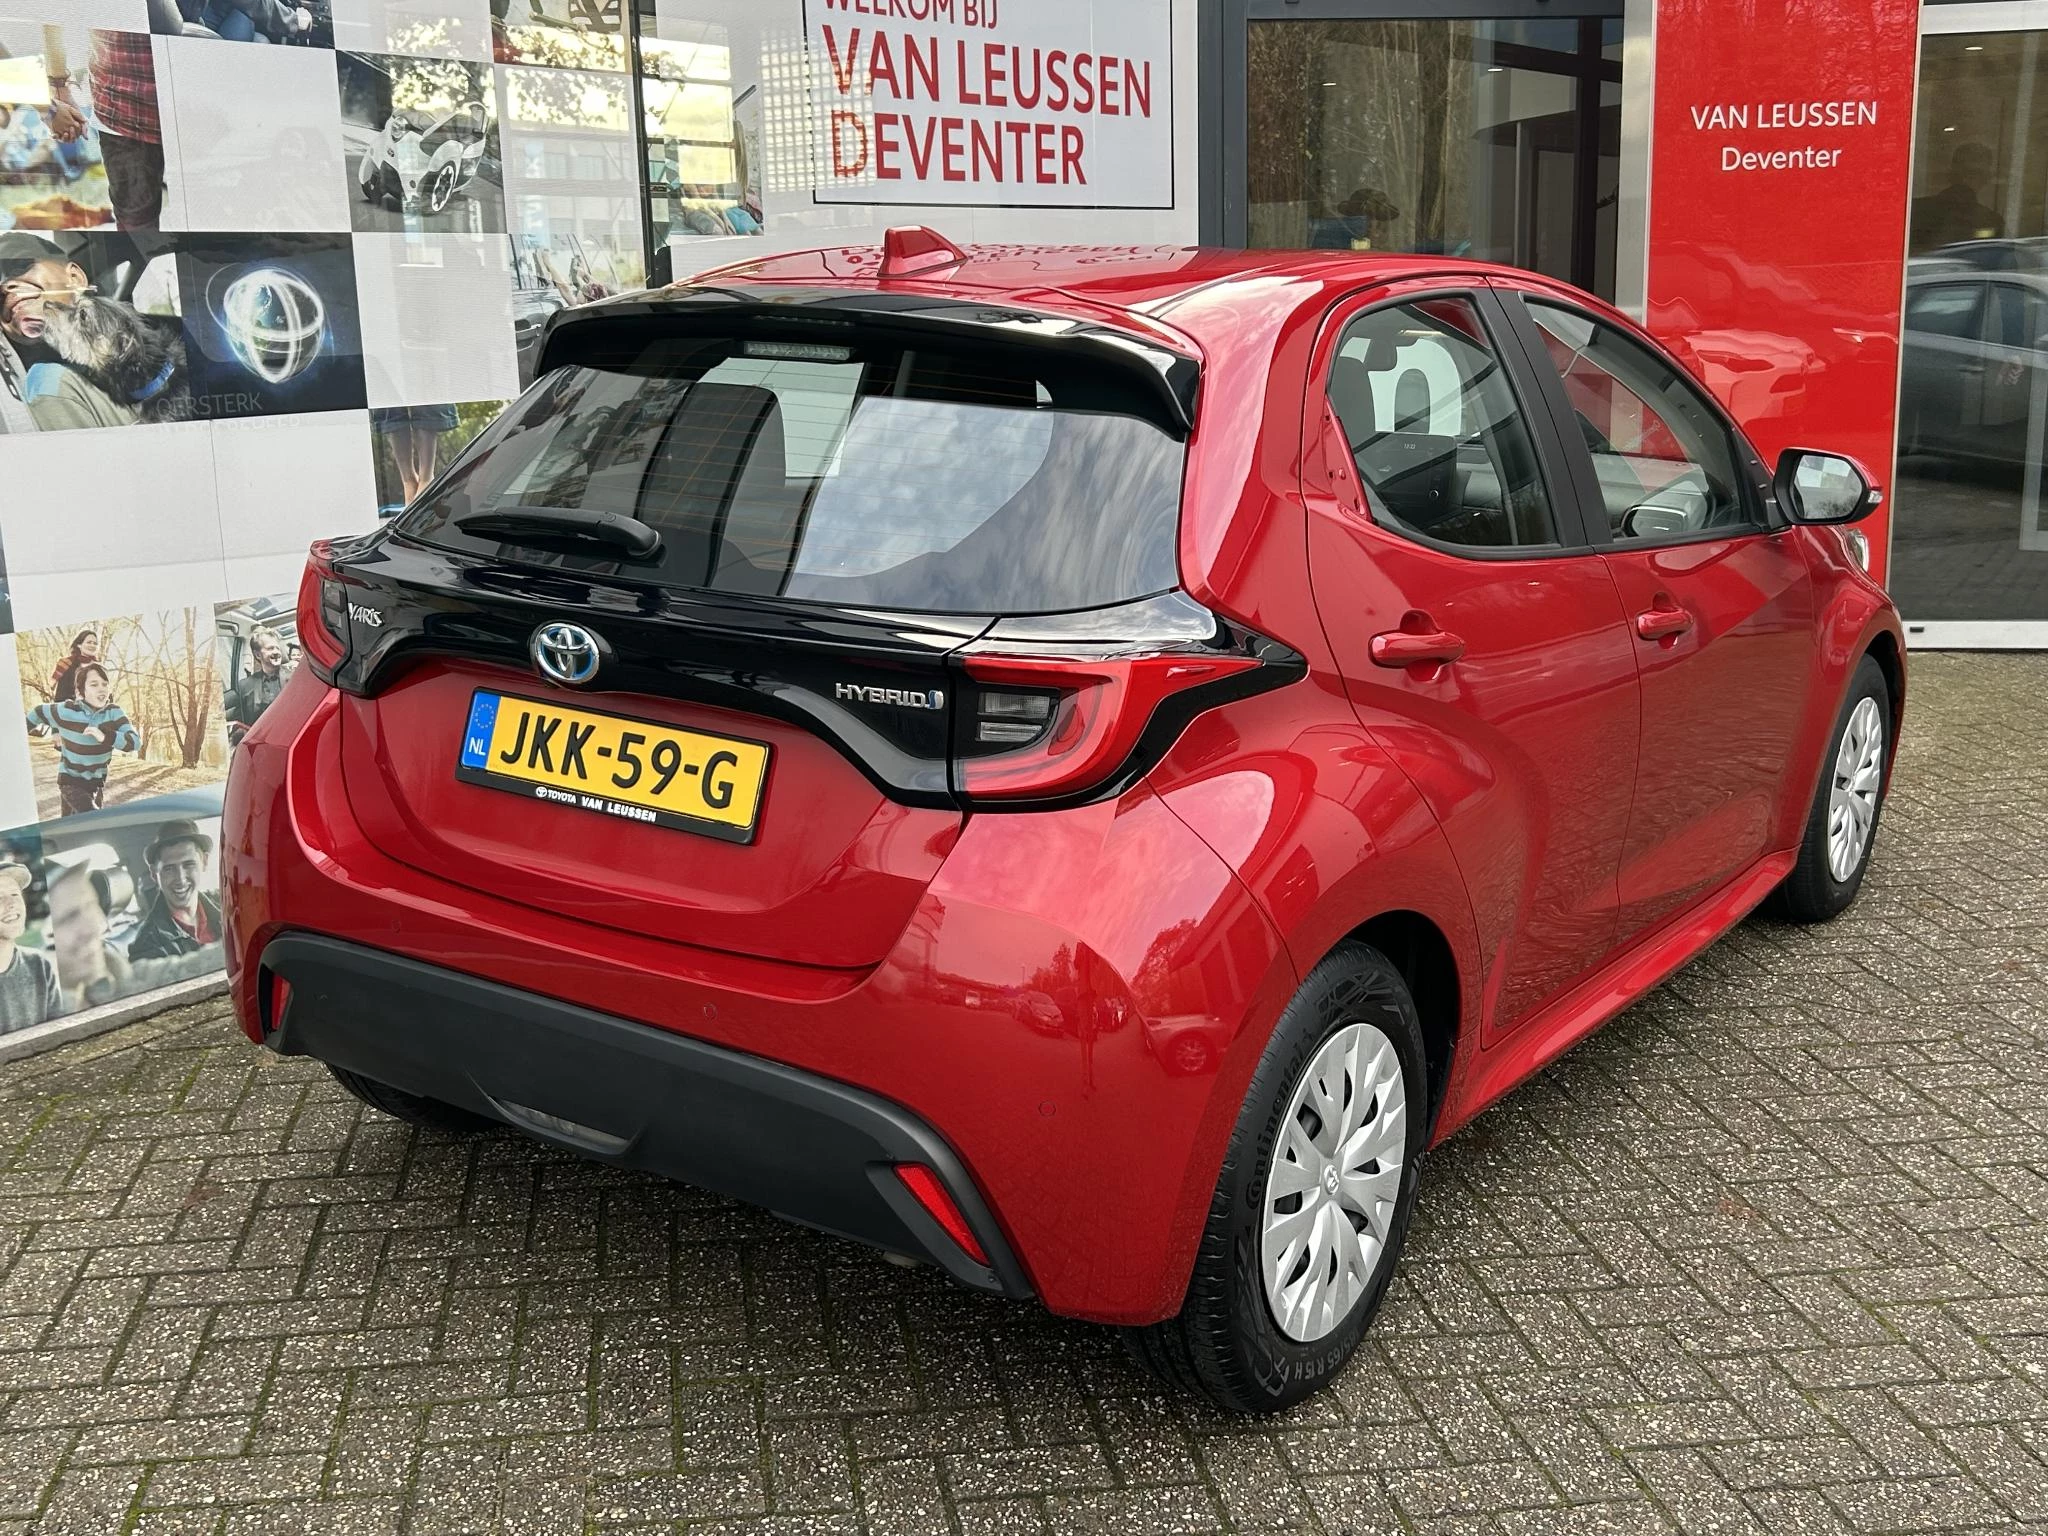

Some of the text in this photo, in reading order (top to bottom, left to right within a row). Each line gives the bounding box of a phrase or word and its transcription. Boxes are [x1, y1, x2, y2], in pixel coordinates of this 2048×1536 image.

[964, 0, 998, 29] BIJ
[822, 24, 1151, 118] VAN LEUSSEN
[1690, 101, 1877, 130] VAN LEUSSEN
[831, 109, 1087, 185] DEVENTER
[1721, 146, 1842, 171] Deventer
[835, 682, 926, 708] HYBRID
[468, 737, 487, 756] NL
[500, 711, 738, 810] JKK-59-G
[547, 789, 657, 823] TOYOTA VAN LEUSSEN
